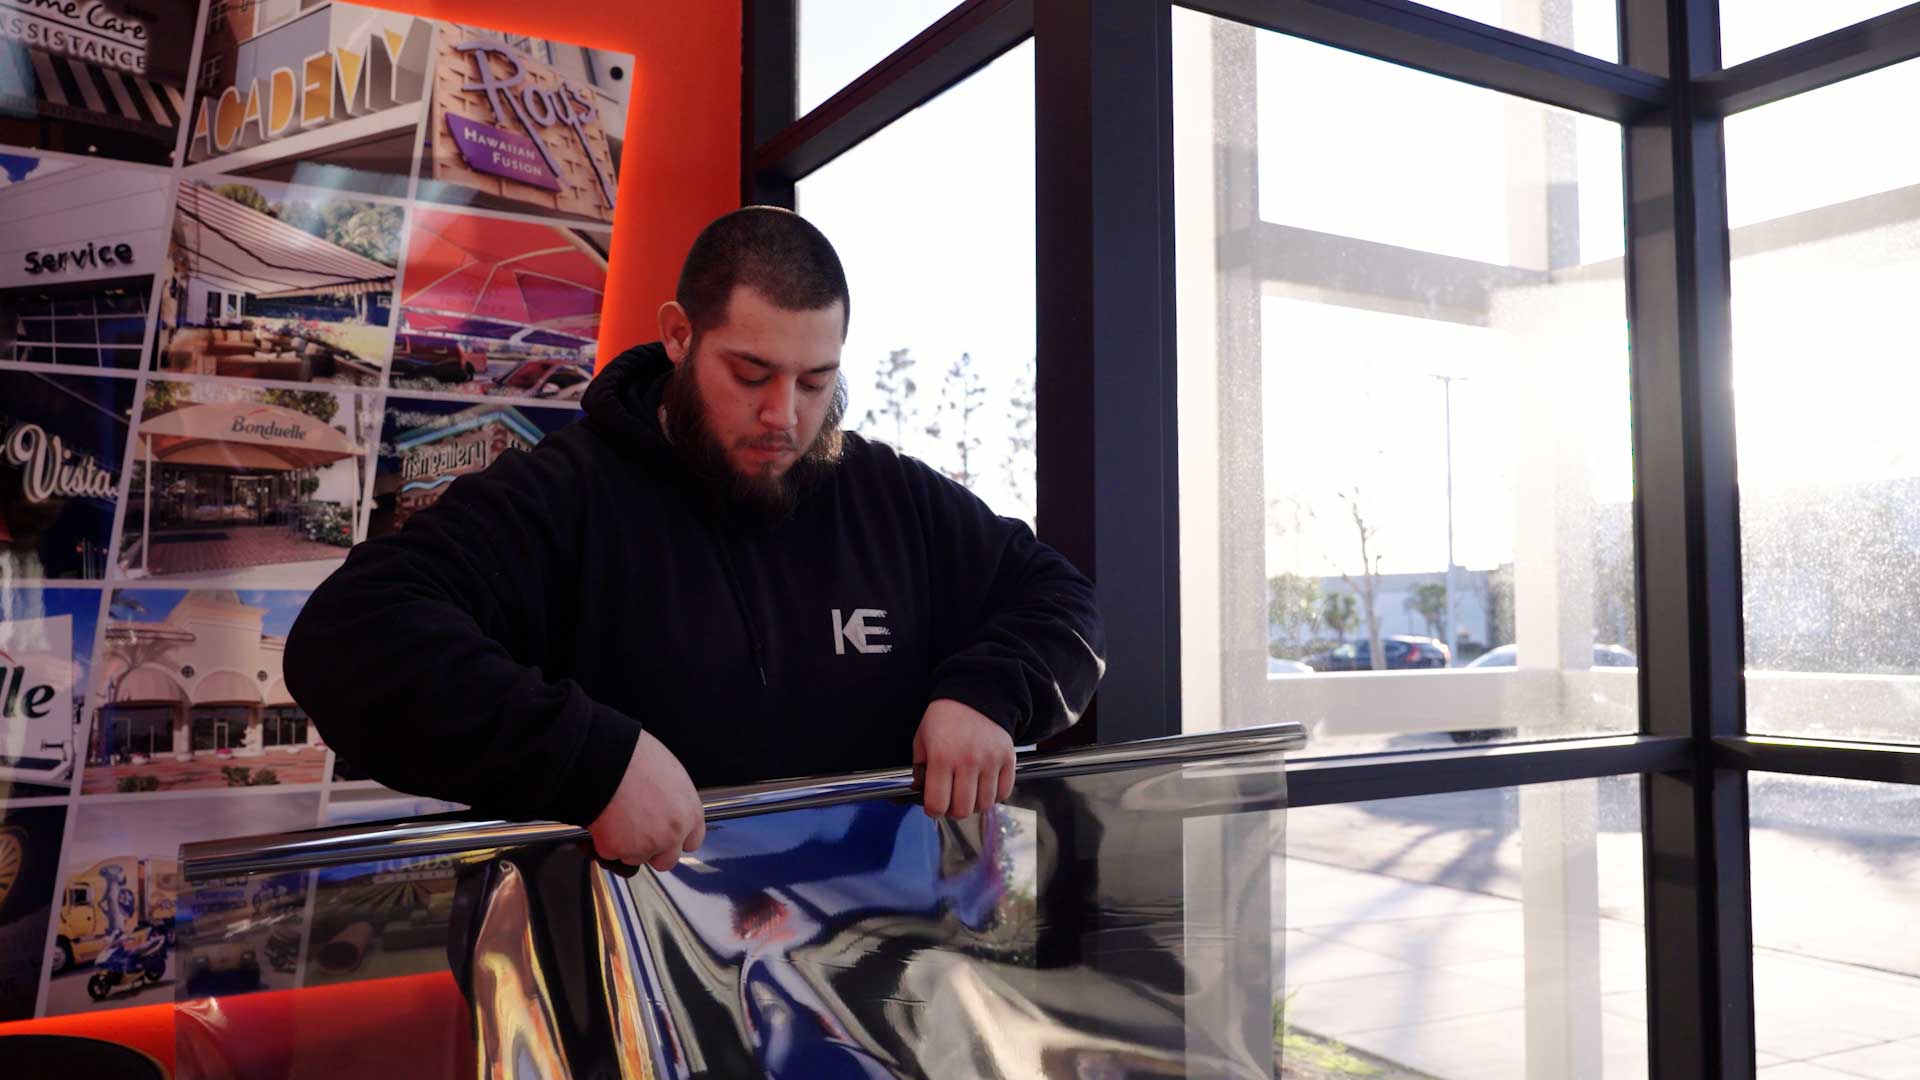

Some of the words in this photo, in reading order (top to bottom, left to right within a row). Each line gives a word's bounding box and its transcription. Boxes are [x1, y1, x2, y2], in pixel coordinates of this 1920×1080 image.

[0, 18, 145, 70] SSISTANCE
[16, 0, 81, 19] me
[87, 4, 147, 40] Care
[188, 26, 407, 161] ACADEMY
[24, 242, 135, 275] Service
[231, 416, 307, 440] Bonduelle
[7, 424, 120, 503] Vista
[831, 608, 893, 655] KE
[0, 666, 55, 719] le
